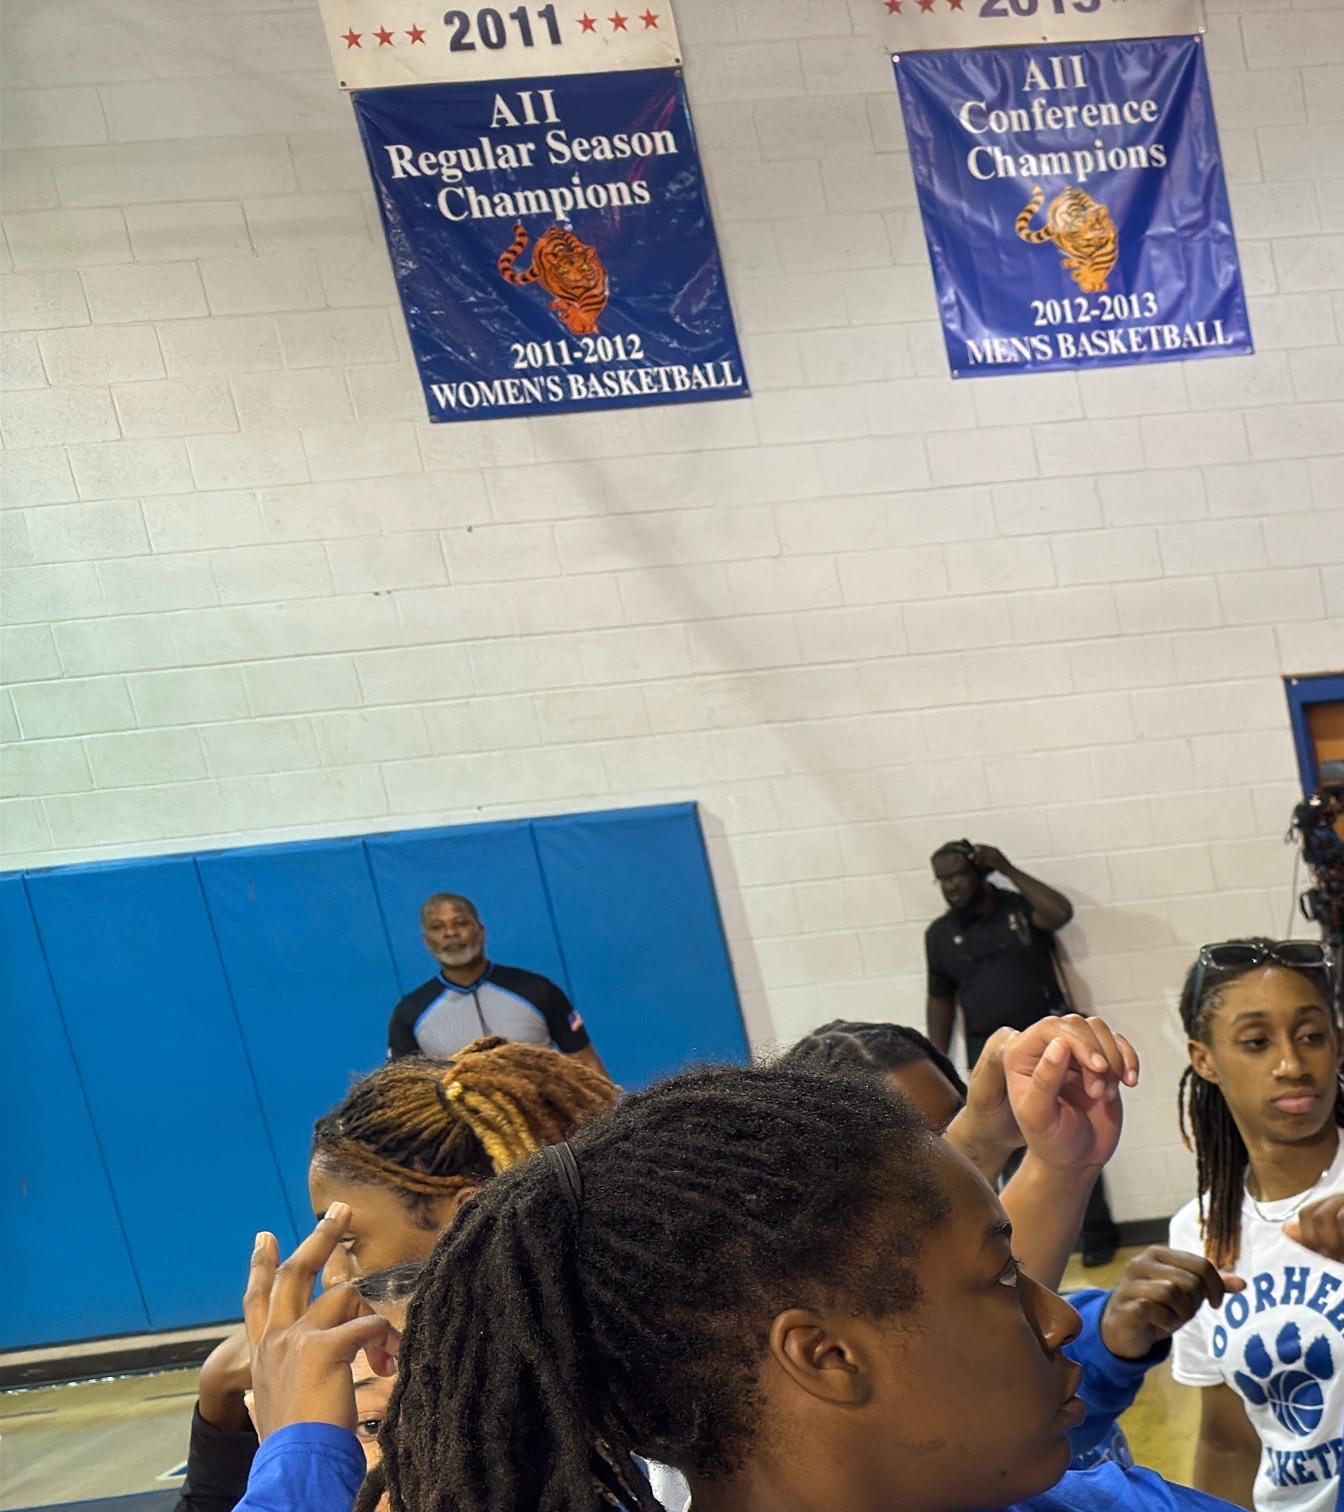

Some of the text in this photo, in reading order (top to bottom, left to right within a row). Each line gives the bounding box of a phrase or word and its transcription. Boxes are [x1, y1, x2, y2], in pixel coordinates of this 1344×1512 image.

[443, 4, 563, 52] 2011
[959, 97, 1158, 134] Conference
[384, 128, 678, 182] Regular Season
[967, 139, 1167, 182] Champions
[437, 175, 651, 222] Champions
[1031, 292, 1158, 326] 2012-2013
[510, 334, 644, 369] 2011-2012
[966, 320, 1233, 365] MEN'S BASKETBALL
[431, 361, 743, 409] WOMEN'S BASKETBALL
